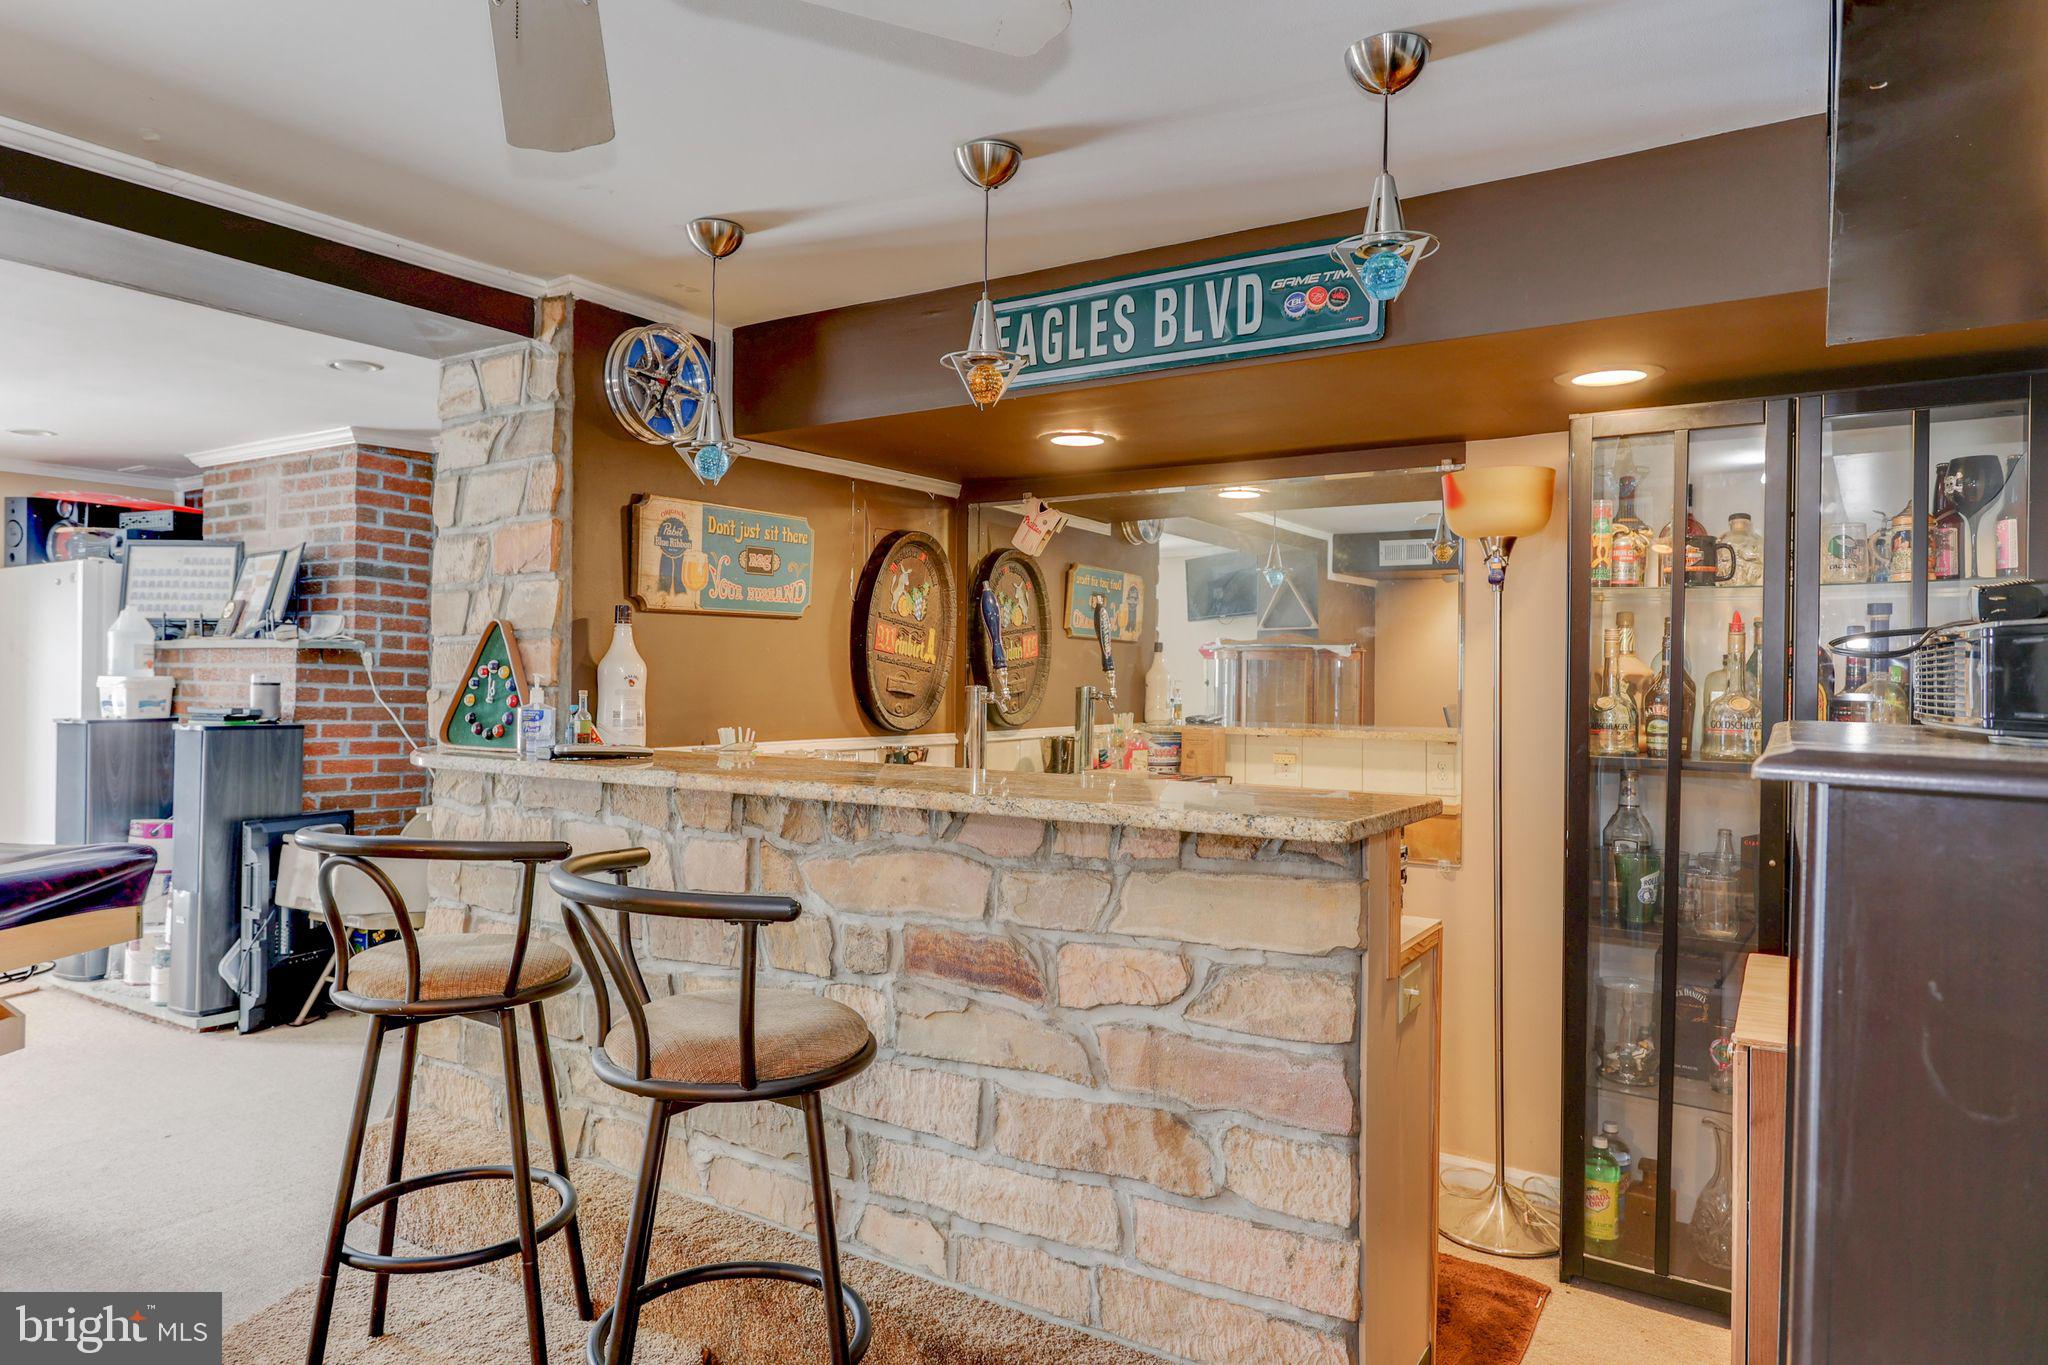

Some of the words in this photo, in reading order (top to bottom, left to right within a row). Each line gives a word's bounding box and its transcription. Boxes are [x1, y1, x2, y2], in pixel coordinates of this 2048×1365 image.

[1271, 273, 1321, 290] GAME
[1323, 267, 1358, 282] TIM
[996, 294, 1135, 367] EAGLES
[1154, 273, 1264, 347] BLVD
[663, 522, 684, 537] Pabst
[735, 521, 760, 543] just
[764, 526, 779, 541] sit
[782, 526, 808, 544] there
[655, 536, 670, 547] Blue
[670, 538, 692, 550] Ribbon
[1585, 1194, 1610, 1202] ANADA
